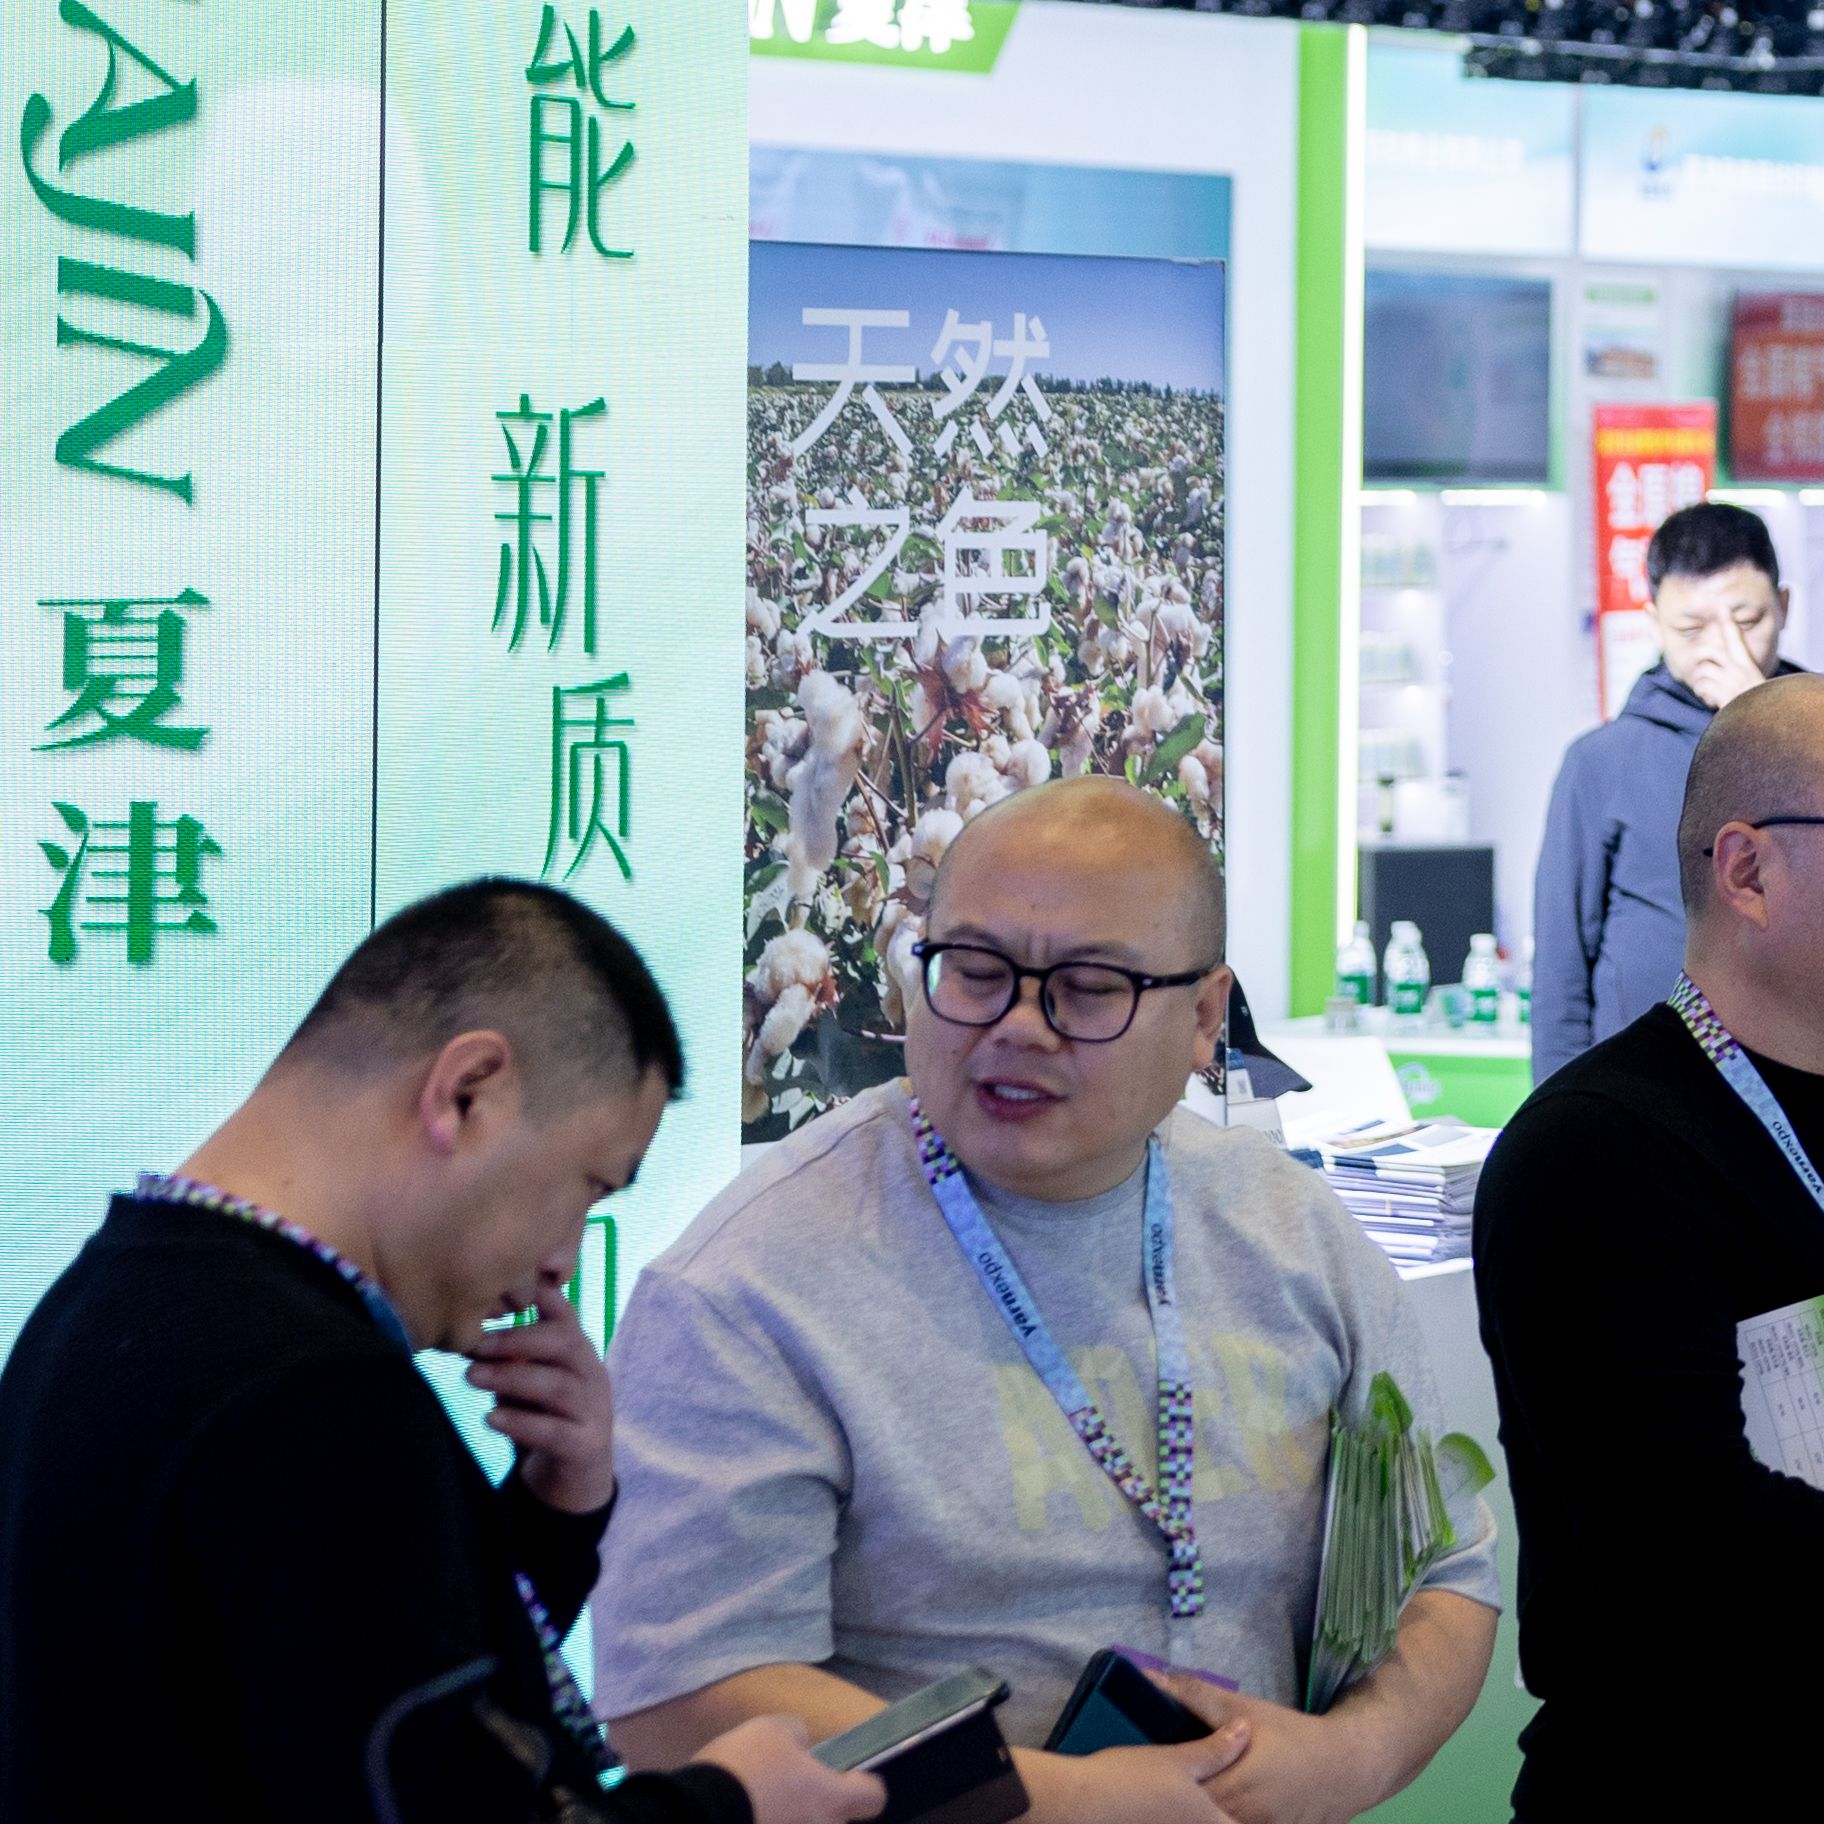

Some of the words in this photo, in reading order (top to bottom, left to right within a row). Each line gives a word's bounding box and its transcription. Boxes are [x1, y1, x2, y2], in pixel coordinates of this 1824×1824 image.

[791, 308, 1053, 460] 天然
[795, 485, 1052, 641] 之色
[31, 587, 225, 966] 夏津
[978, 1251, 1038, 1339] yarnexpo
